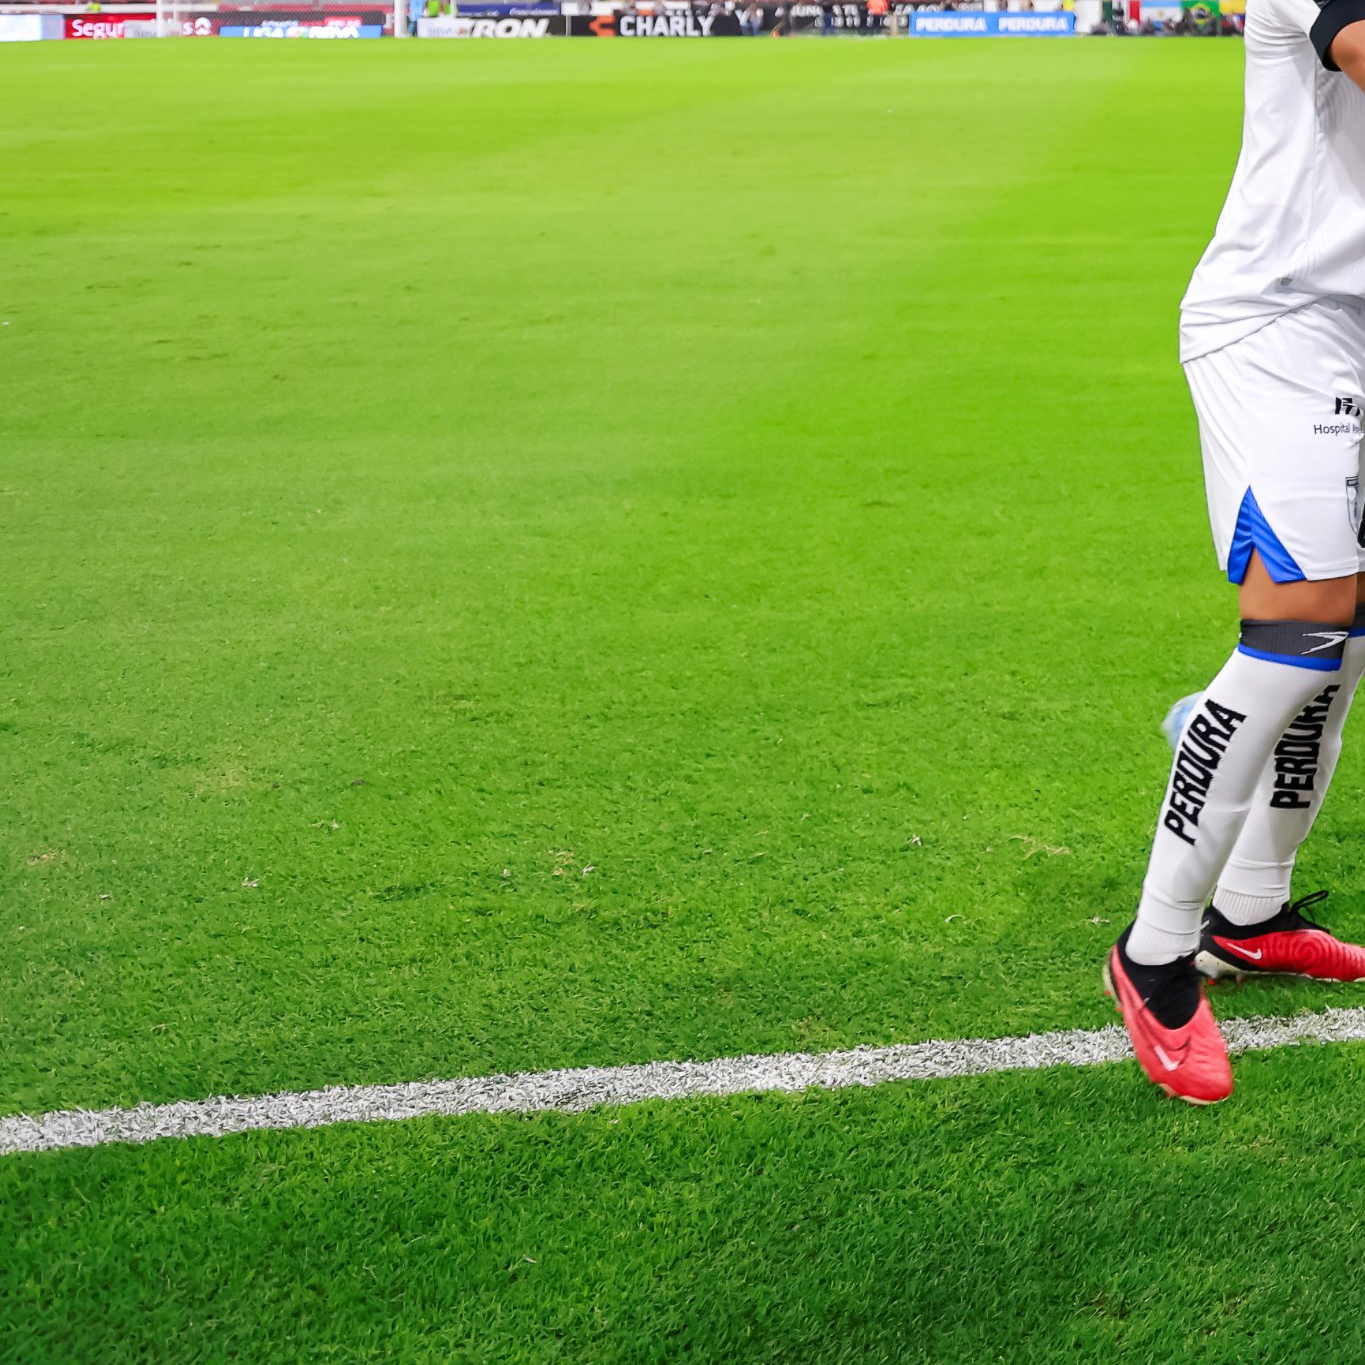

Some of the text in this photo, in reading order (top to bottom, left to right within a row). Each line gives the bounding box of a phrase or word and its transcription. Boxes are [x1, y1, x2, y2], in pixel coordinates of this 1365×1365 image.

[619, 15, 716, 37] CHARLY
[915, 17, 987, 32] PERDURA
[998, 17, 1069, 32] PERDURA
[1313, 423, 1350, 436] Hospital
[1164, 698, 1248, 846] PERDURA
